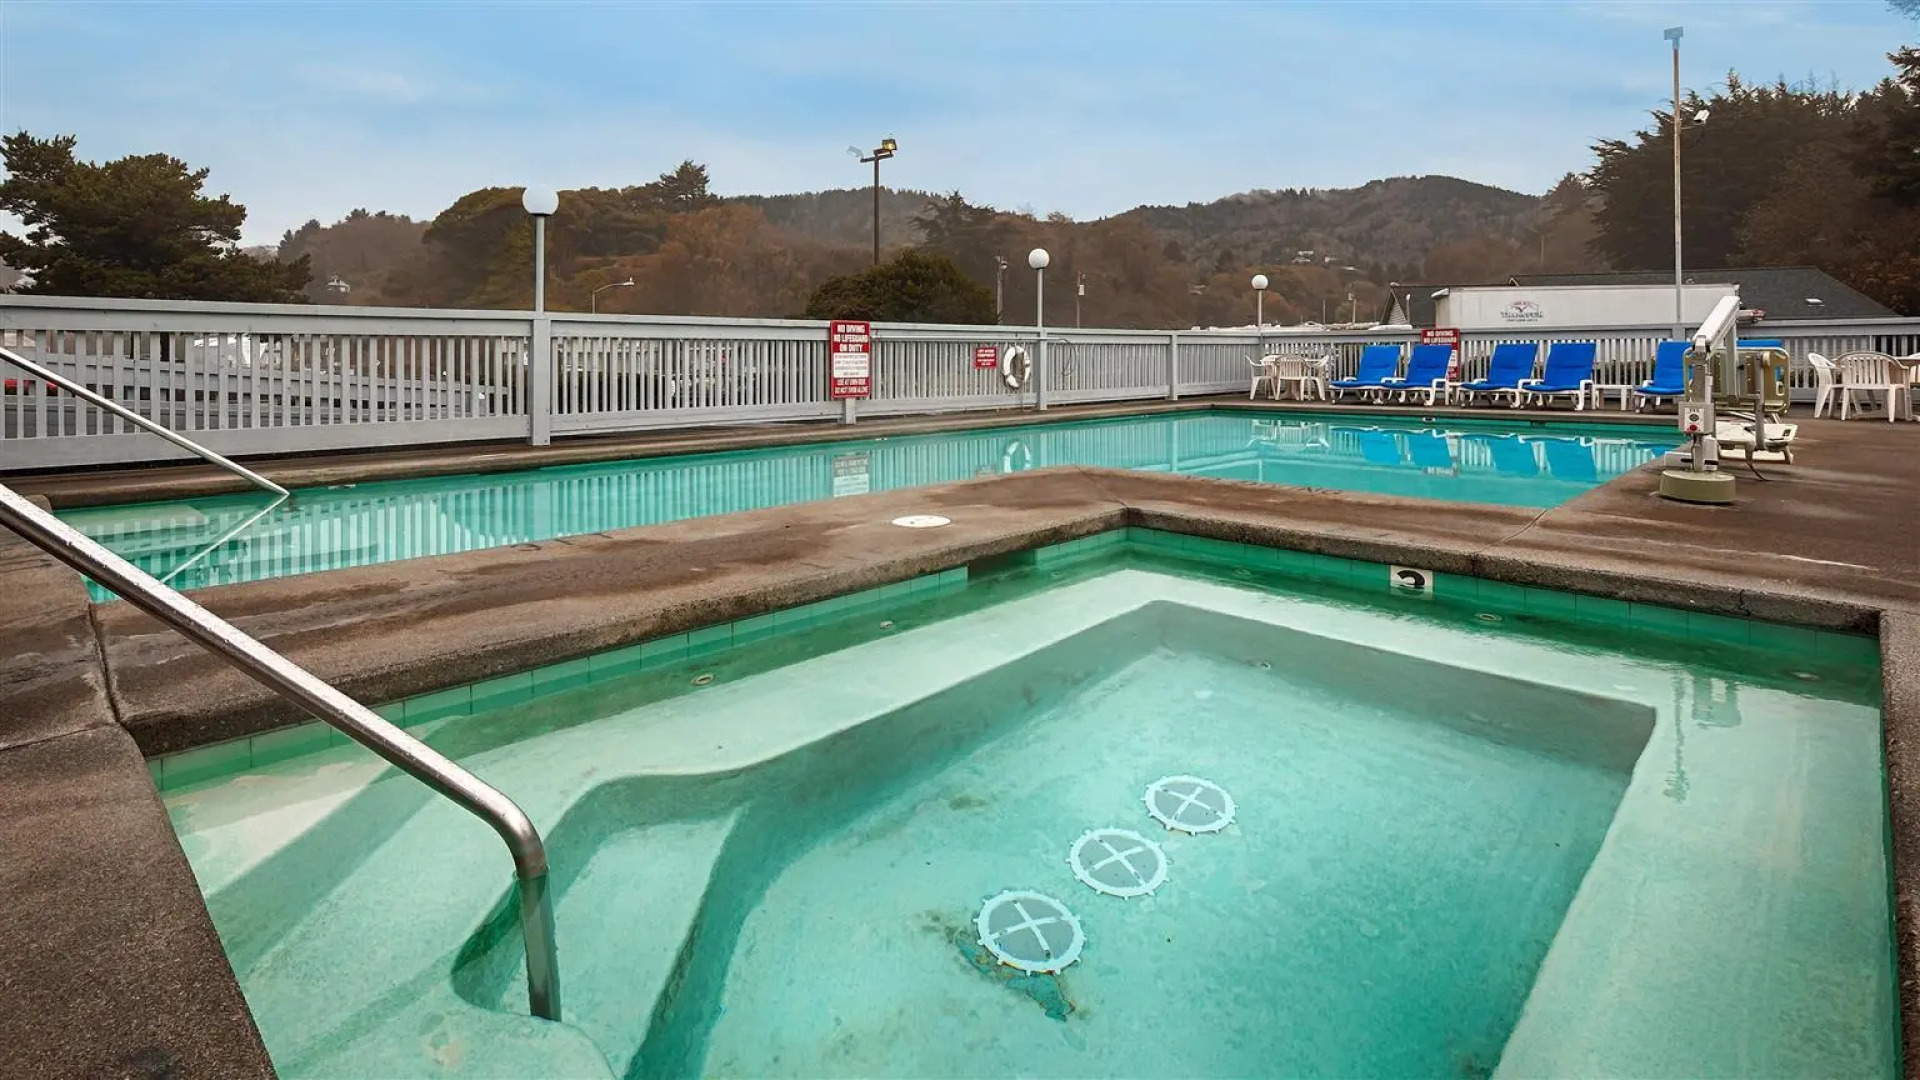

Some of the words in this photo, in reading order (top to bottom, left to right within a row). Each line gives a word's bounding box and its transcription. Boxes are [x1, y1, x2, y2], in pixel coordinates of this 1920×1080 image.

[837, 324, 846, 333] NO
[846, 324, 866, 333] DIVING
[833, 334, 841, 342] NO
[841, 334, 868, 343] LIFEGUARD
[839, 343, 848, 352] ON
[848, 343, 863, 352] DUTY
